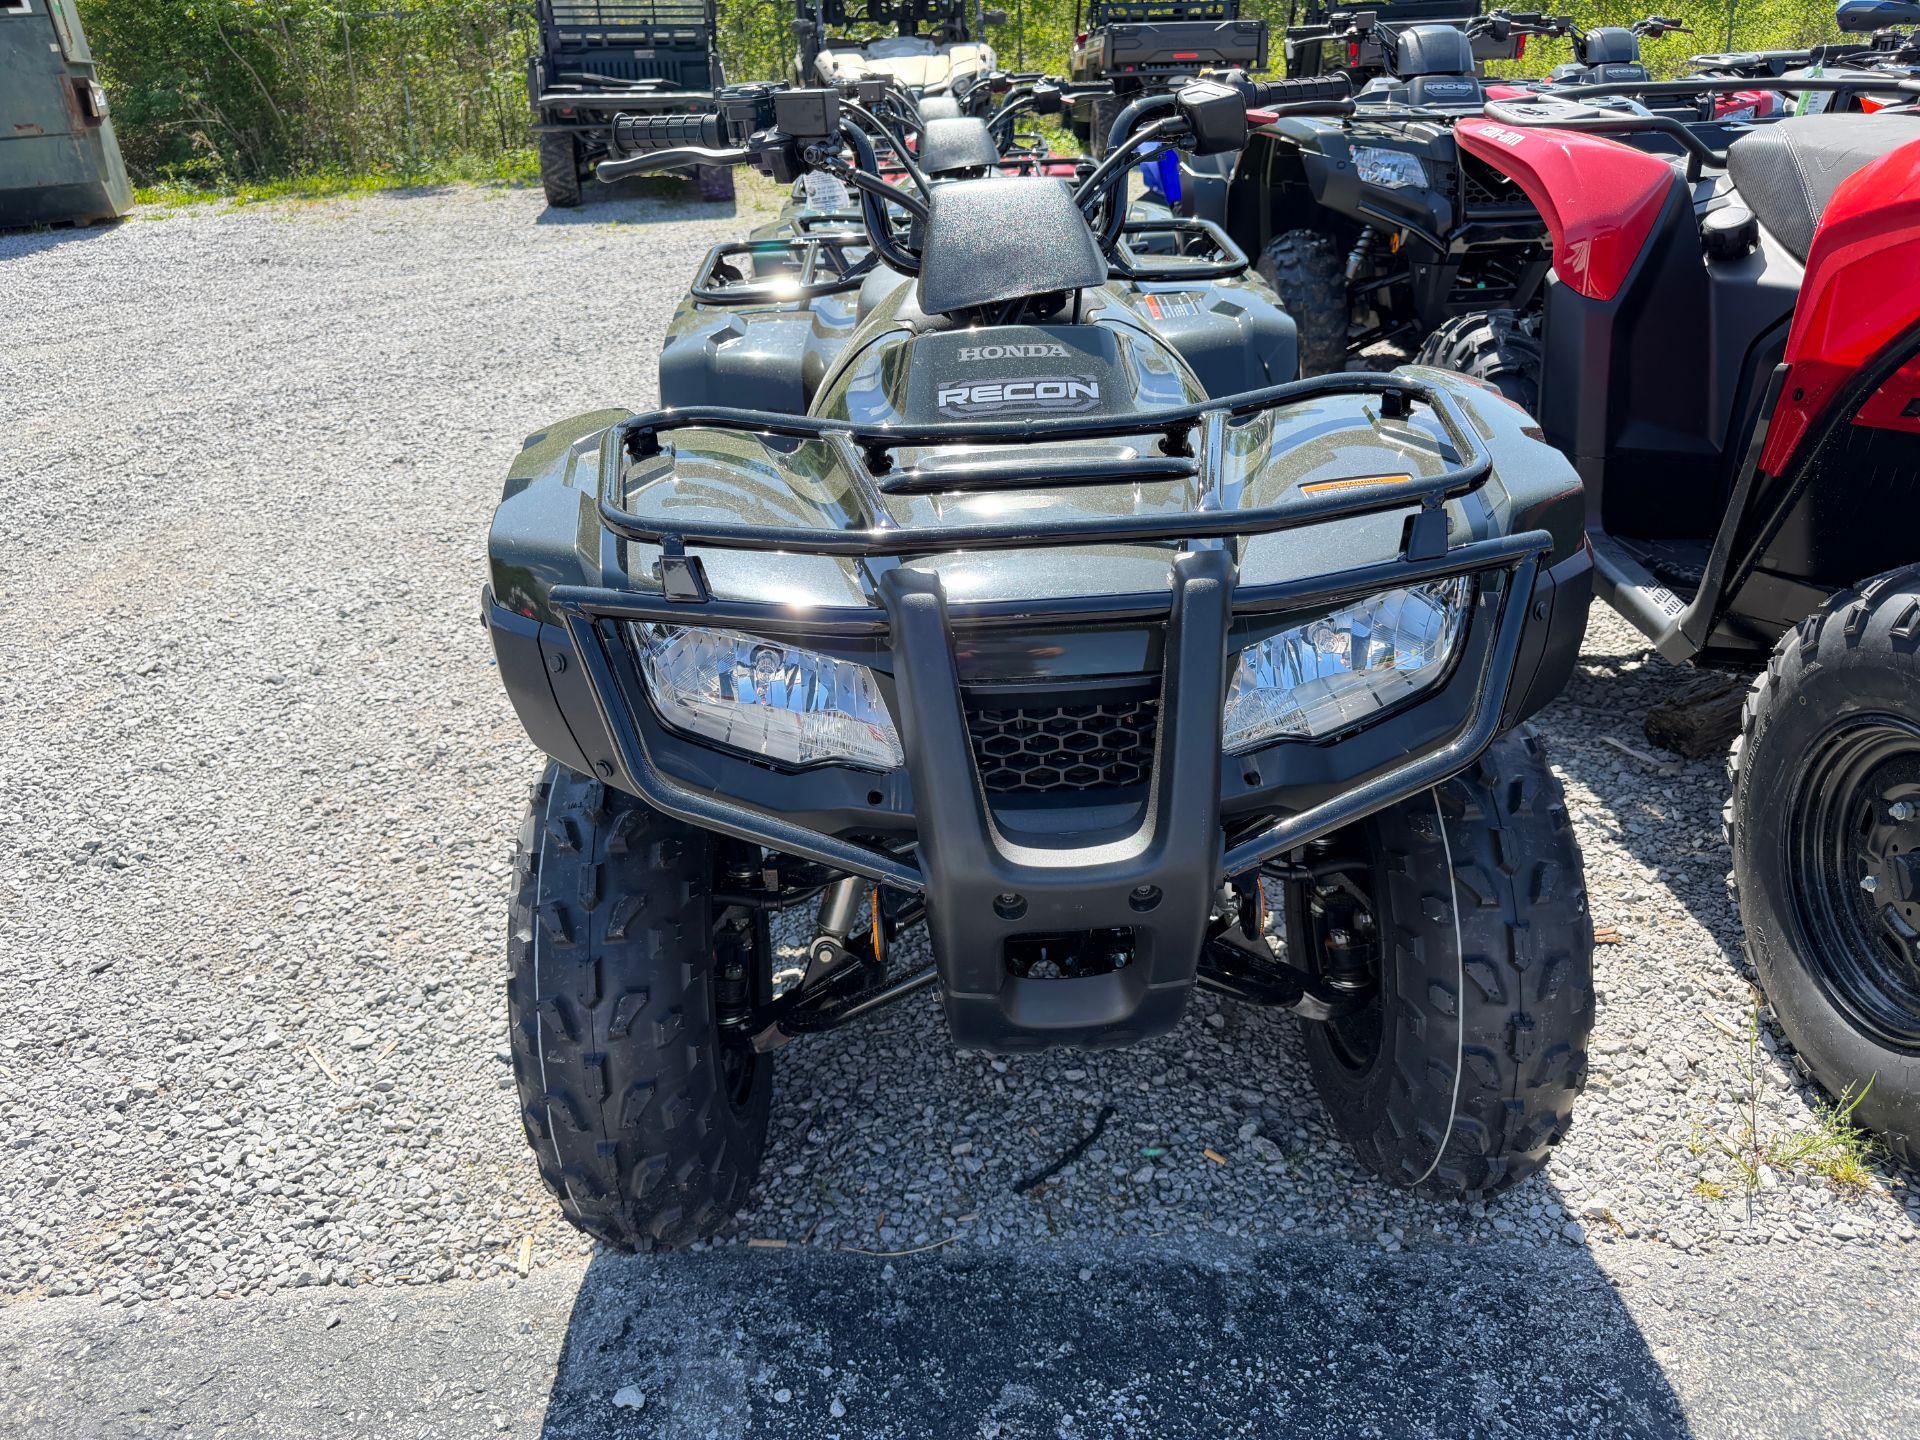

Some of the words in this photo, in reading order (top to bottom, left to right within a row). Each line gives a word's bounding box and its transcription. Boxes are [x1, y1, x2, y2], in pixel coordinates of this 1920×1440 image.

[1477, 126, 1525, 146] can-am
[958, 344, 1070, 361] HONDA
[938, 382, 1100, 407] RECON
